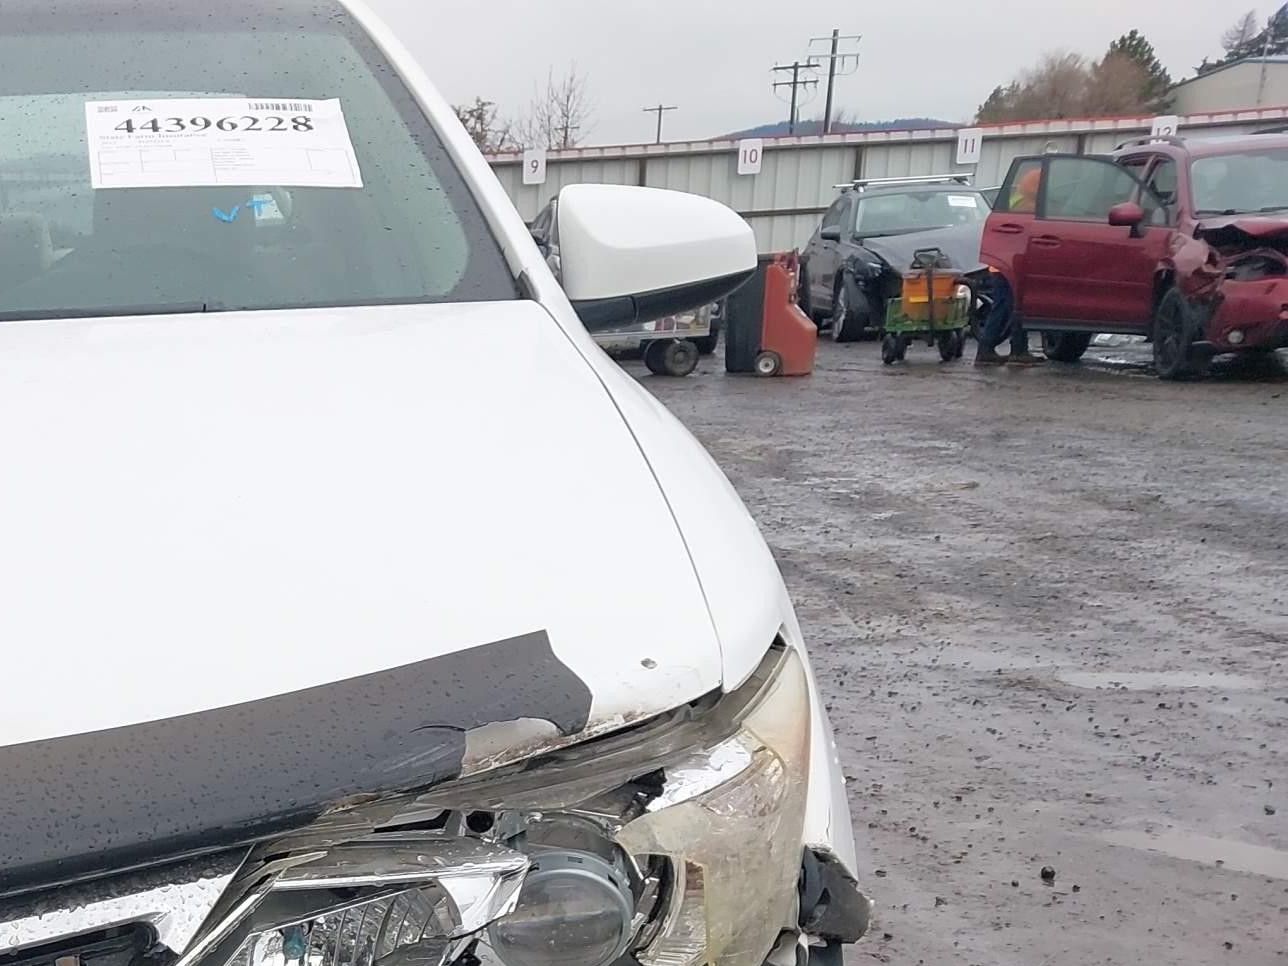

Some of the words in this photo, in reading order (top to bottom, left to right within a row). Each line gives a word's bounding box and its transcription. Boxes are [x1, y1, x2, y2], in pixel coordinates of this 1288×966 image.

[114, 115, 314, 133] 44396228
[963, 138, 976, 154] 11
[742, 148, 758, 164] 10
[530, 159, 539, 174] 9
